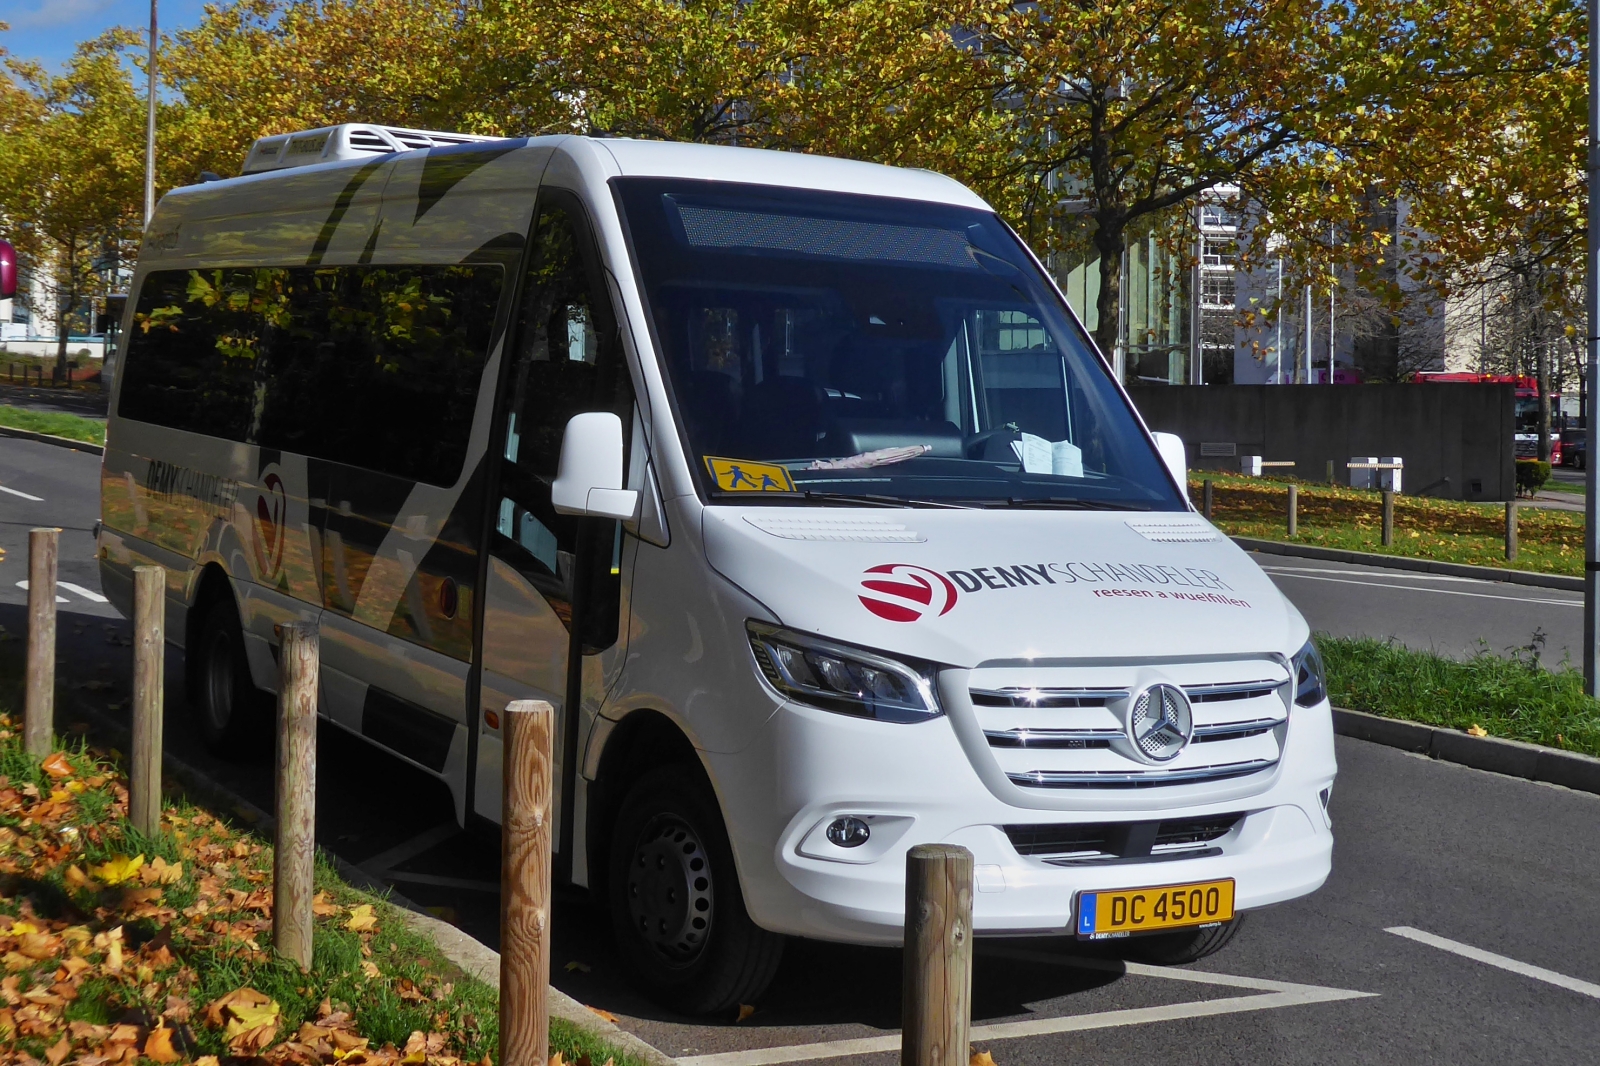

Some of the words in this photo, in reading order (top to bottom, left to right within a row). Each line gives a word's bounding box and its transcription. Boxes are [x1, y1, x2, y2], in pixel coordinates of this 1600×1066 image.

[1321, 372, 1345, 381] Cre
[1092, 588, 1154, 598] reesen
[1155, 590, 1168, 599] a
[1169, 591, 1252, 609] wuelfillen
[1111, 894, 1146, 926] DC
[1153, 887, 1220, 922] 4500
[1084, 916, 1090, 926] L
